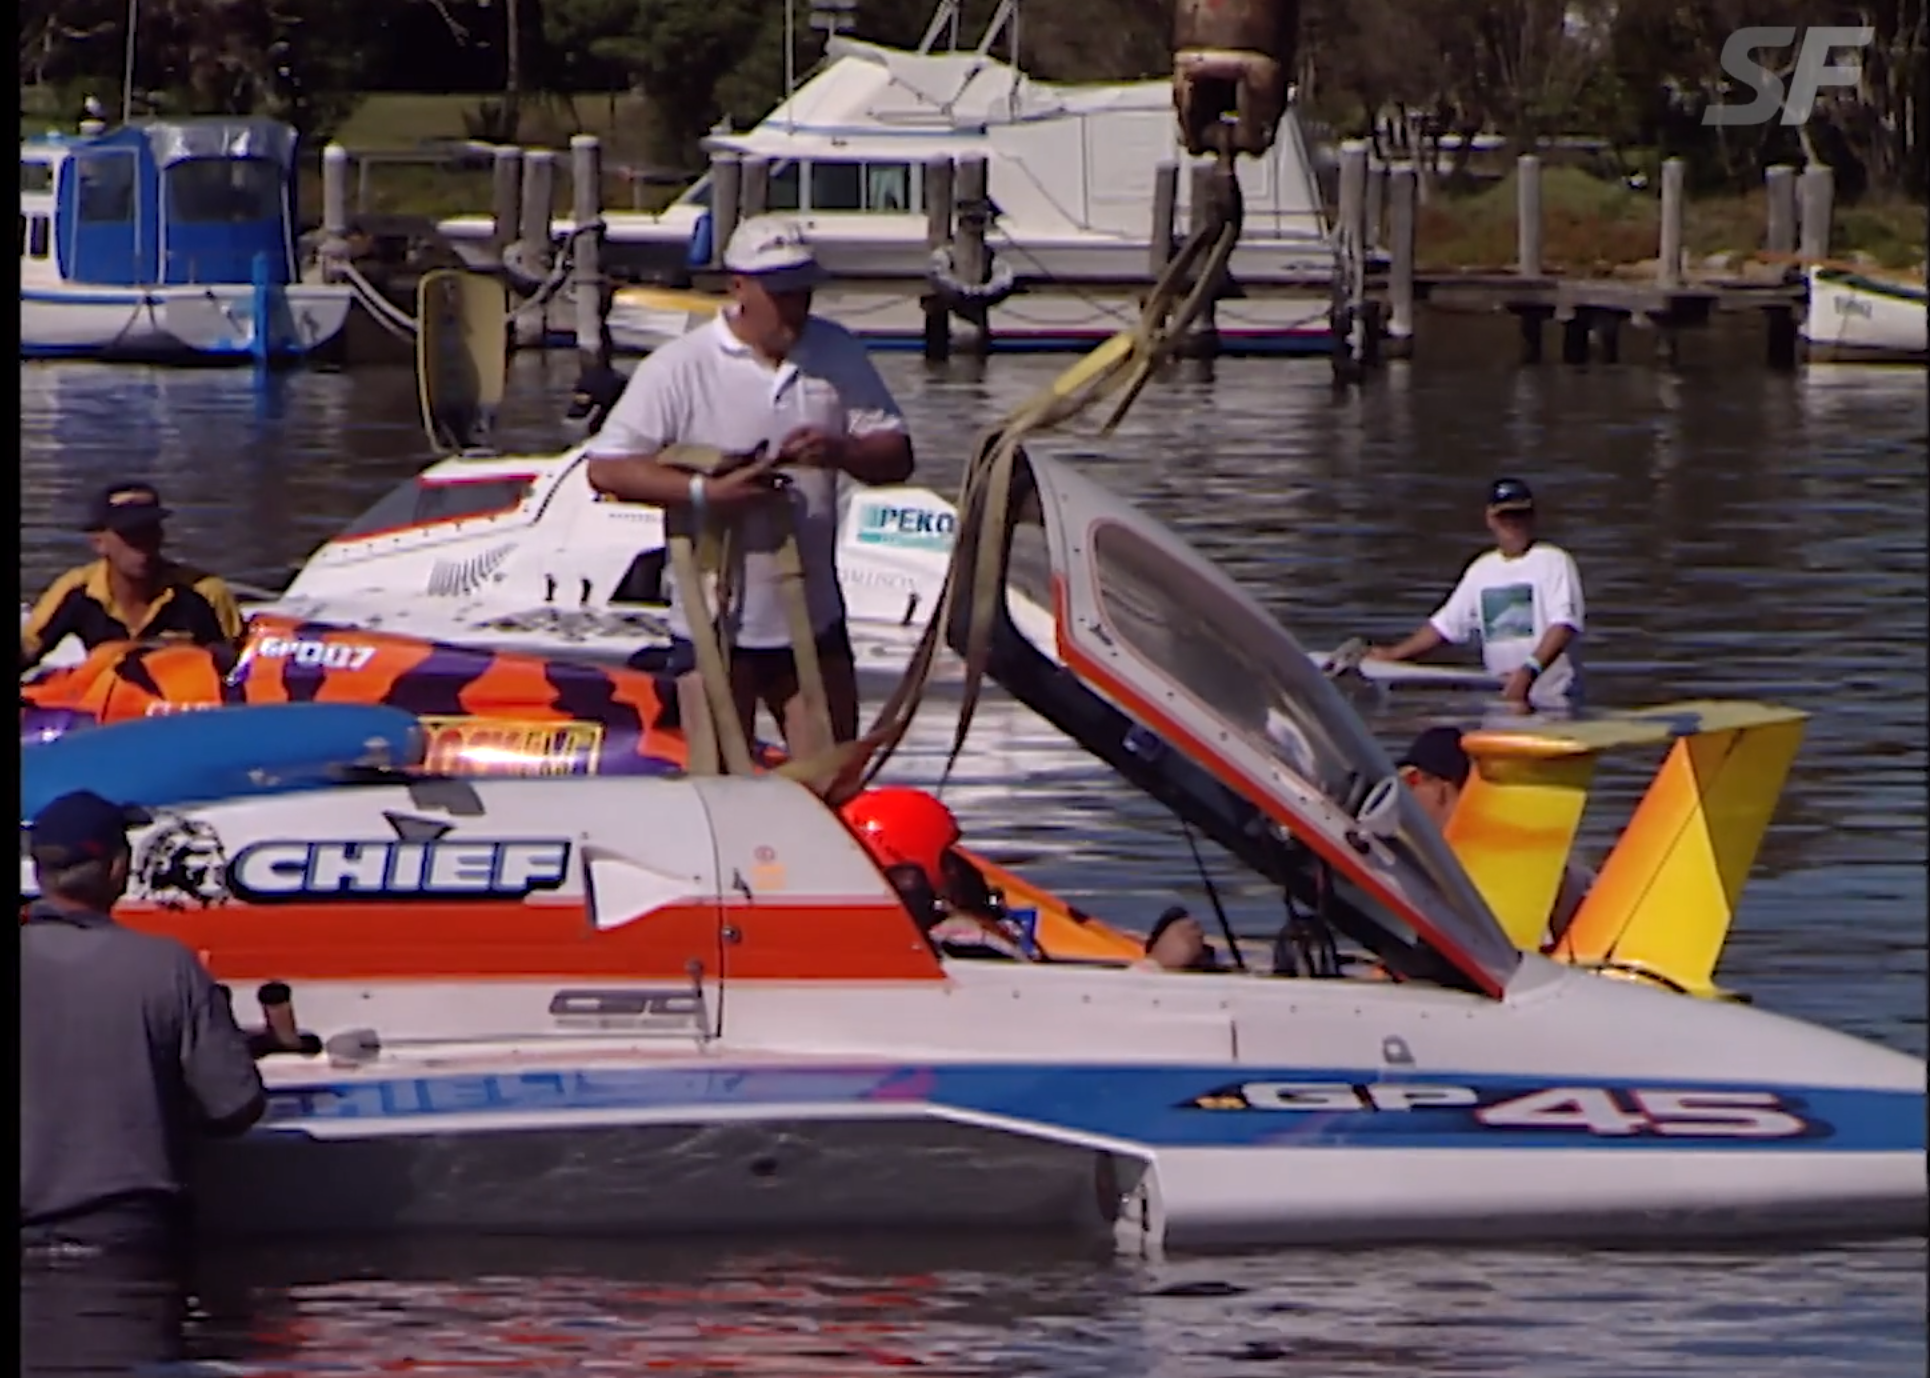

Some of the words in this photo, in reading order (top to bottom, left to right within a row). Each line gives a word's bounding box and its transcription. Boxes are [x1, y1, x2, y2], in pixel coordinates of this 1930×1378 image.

[234, 842, 567, 895] CHIEF
[1241, 1081, 1479, 1112] GP
[1475, 1085, 1806, 1138] 45
